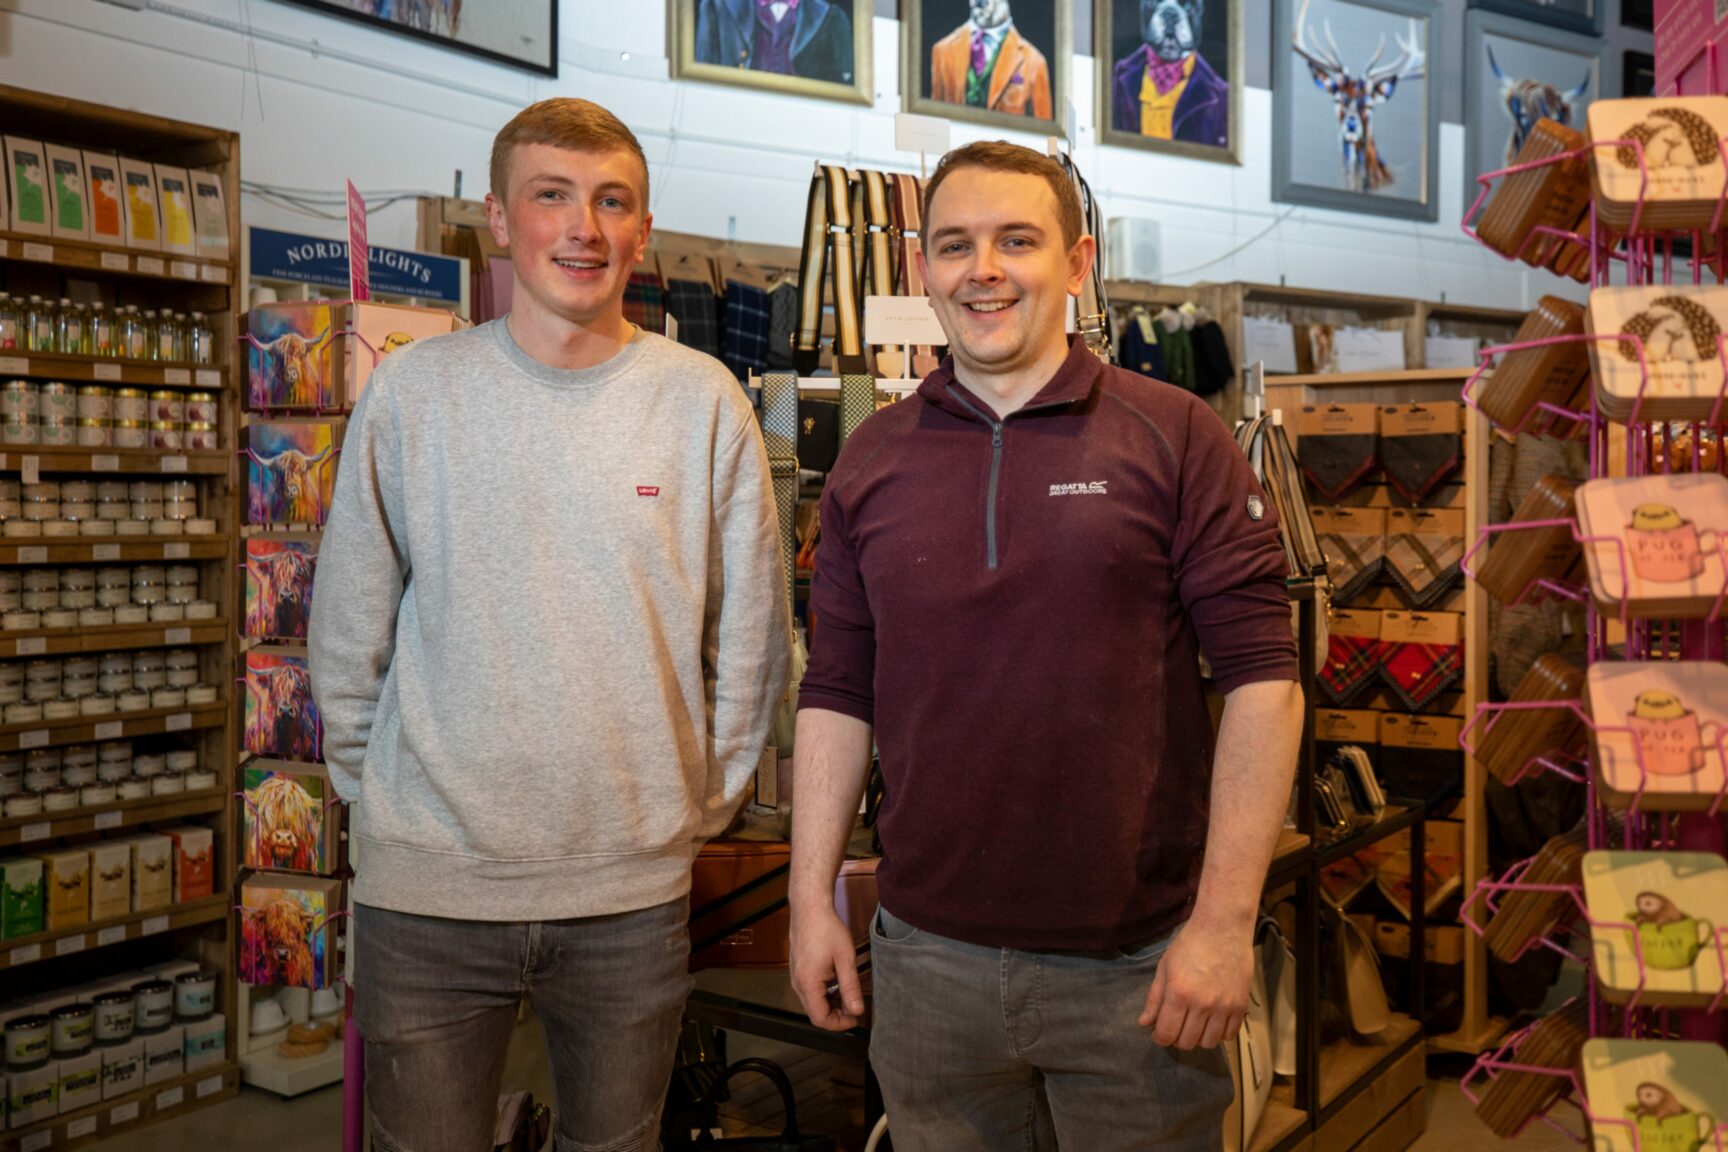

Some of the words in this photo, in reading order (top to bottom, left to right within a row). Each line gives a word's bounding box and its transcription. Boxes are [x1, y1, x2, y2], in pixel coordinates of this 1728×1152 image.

[286, 242, 350, 265] NORDI
[368, 247, 432, 284] LIGHTS
[1049, 482, 1087, 491] REGATTA
[1637, 539, 1684, 552] PUG
[1640, 728, 1685, 742] PUG
